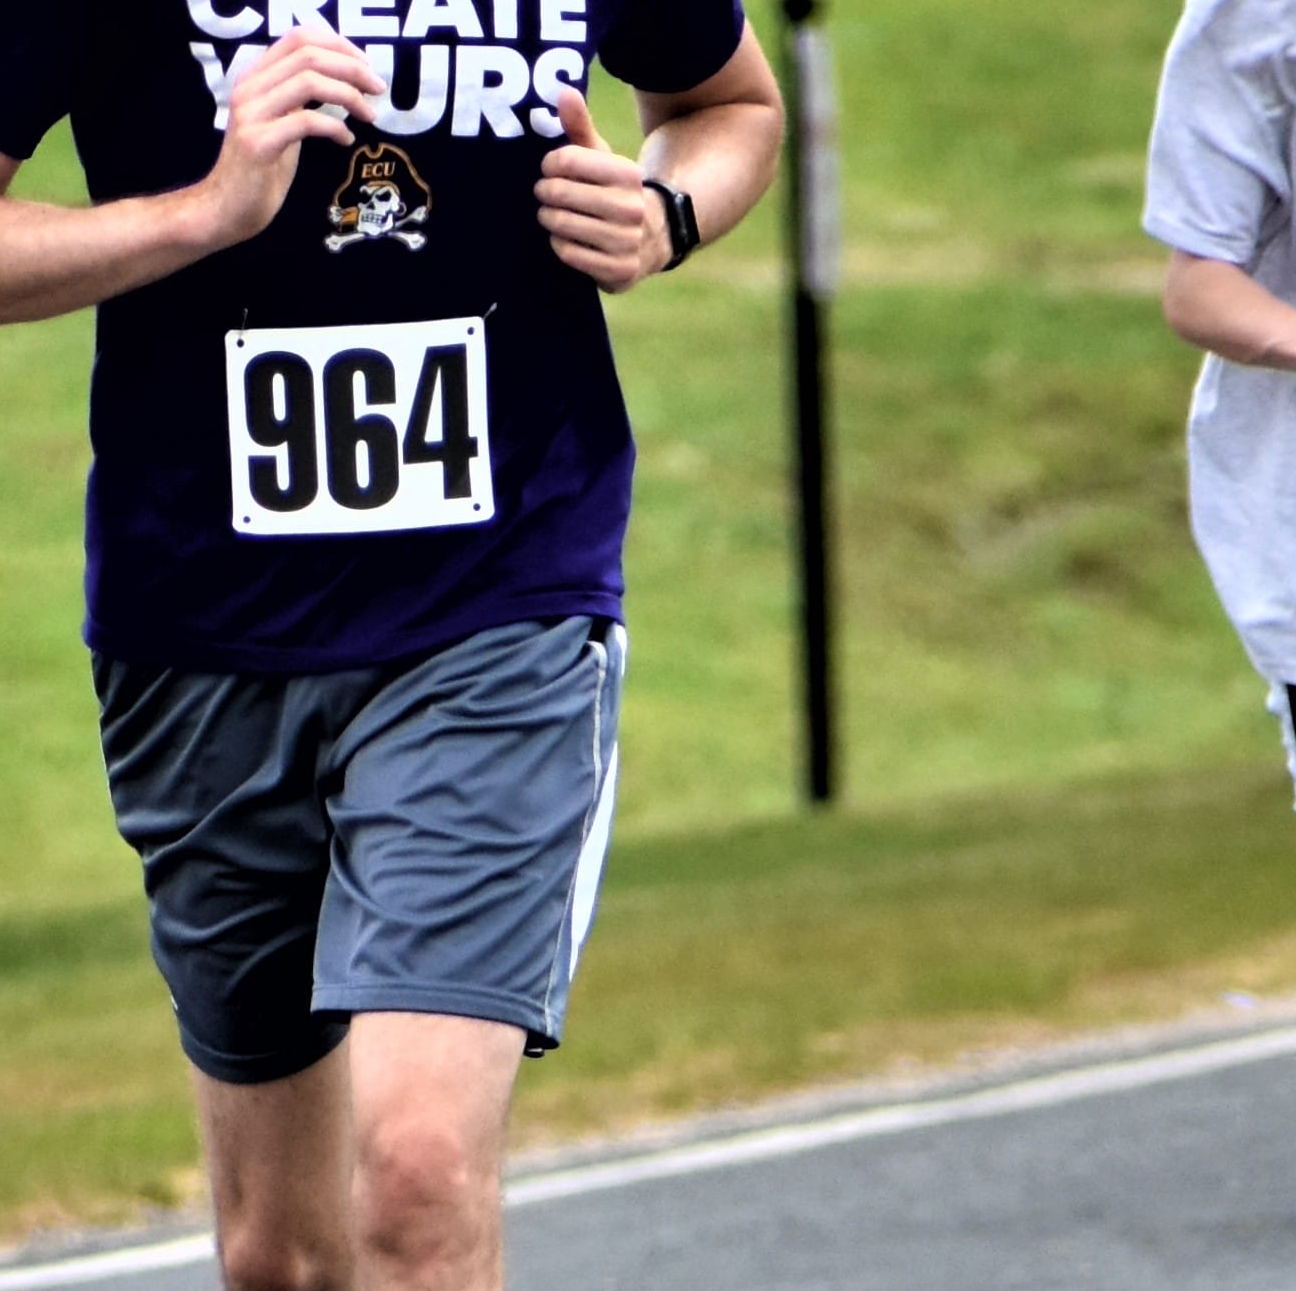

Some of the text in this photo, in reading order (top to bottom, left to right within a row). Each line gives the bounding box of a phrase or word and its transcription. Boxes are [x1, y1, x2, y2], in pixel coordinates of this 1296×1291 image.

[189, 42, 585, 138] YURS
[361, 161, 395, 179] ECU
[244, 343, 478, 513] 964
